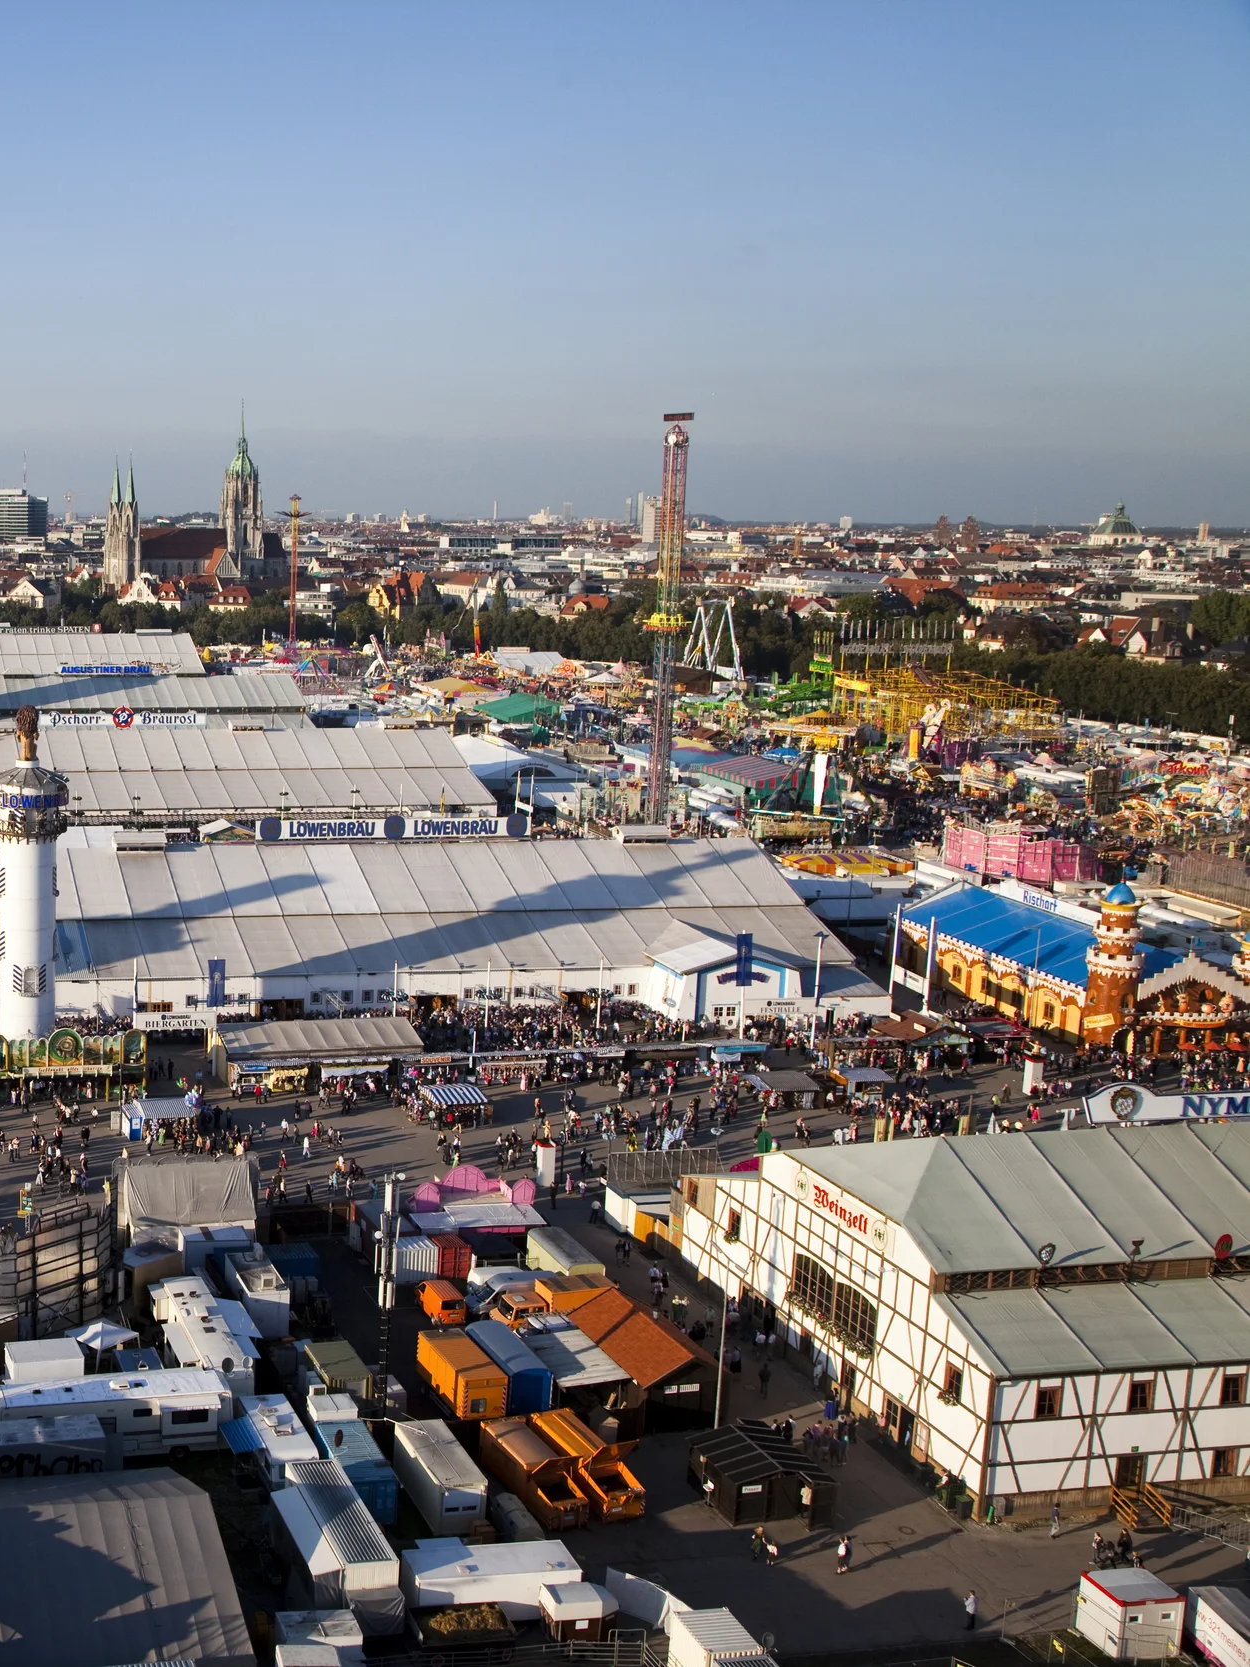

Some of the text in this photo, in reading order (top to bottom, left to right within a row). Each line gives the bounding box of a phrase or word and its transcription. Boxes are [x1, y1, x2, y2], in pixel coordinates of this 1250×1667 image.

[61, 665, 150, 674] AUGUSTINER BRÄU
[140, 711, 197, 724] Bräurosl
[289, 820, 376, 837] LÖWENBRÄU
[413, 819, 499, 835] LÖWENBRÄU
[1023, 890, 1058, 912] Rischart
[145, 1020, 207, 1028] BIERGARTEN
[1179, 1095, 1250, 1117] NYM
[813, 1184, 868, 1235] Weinzelt
